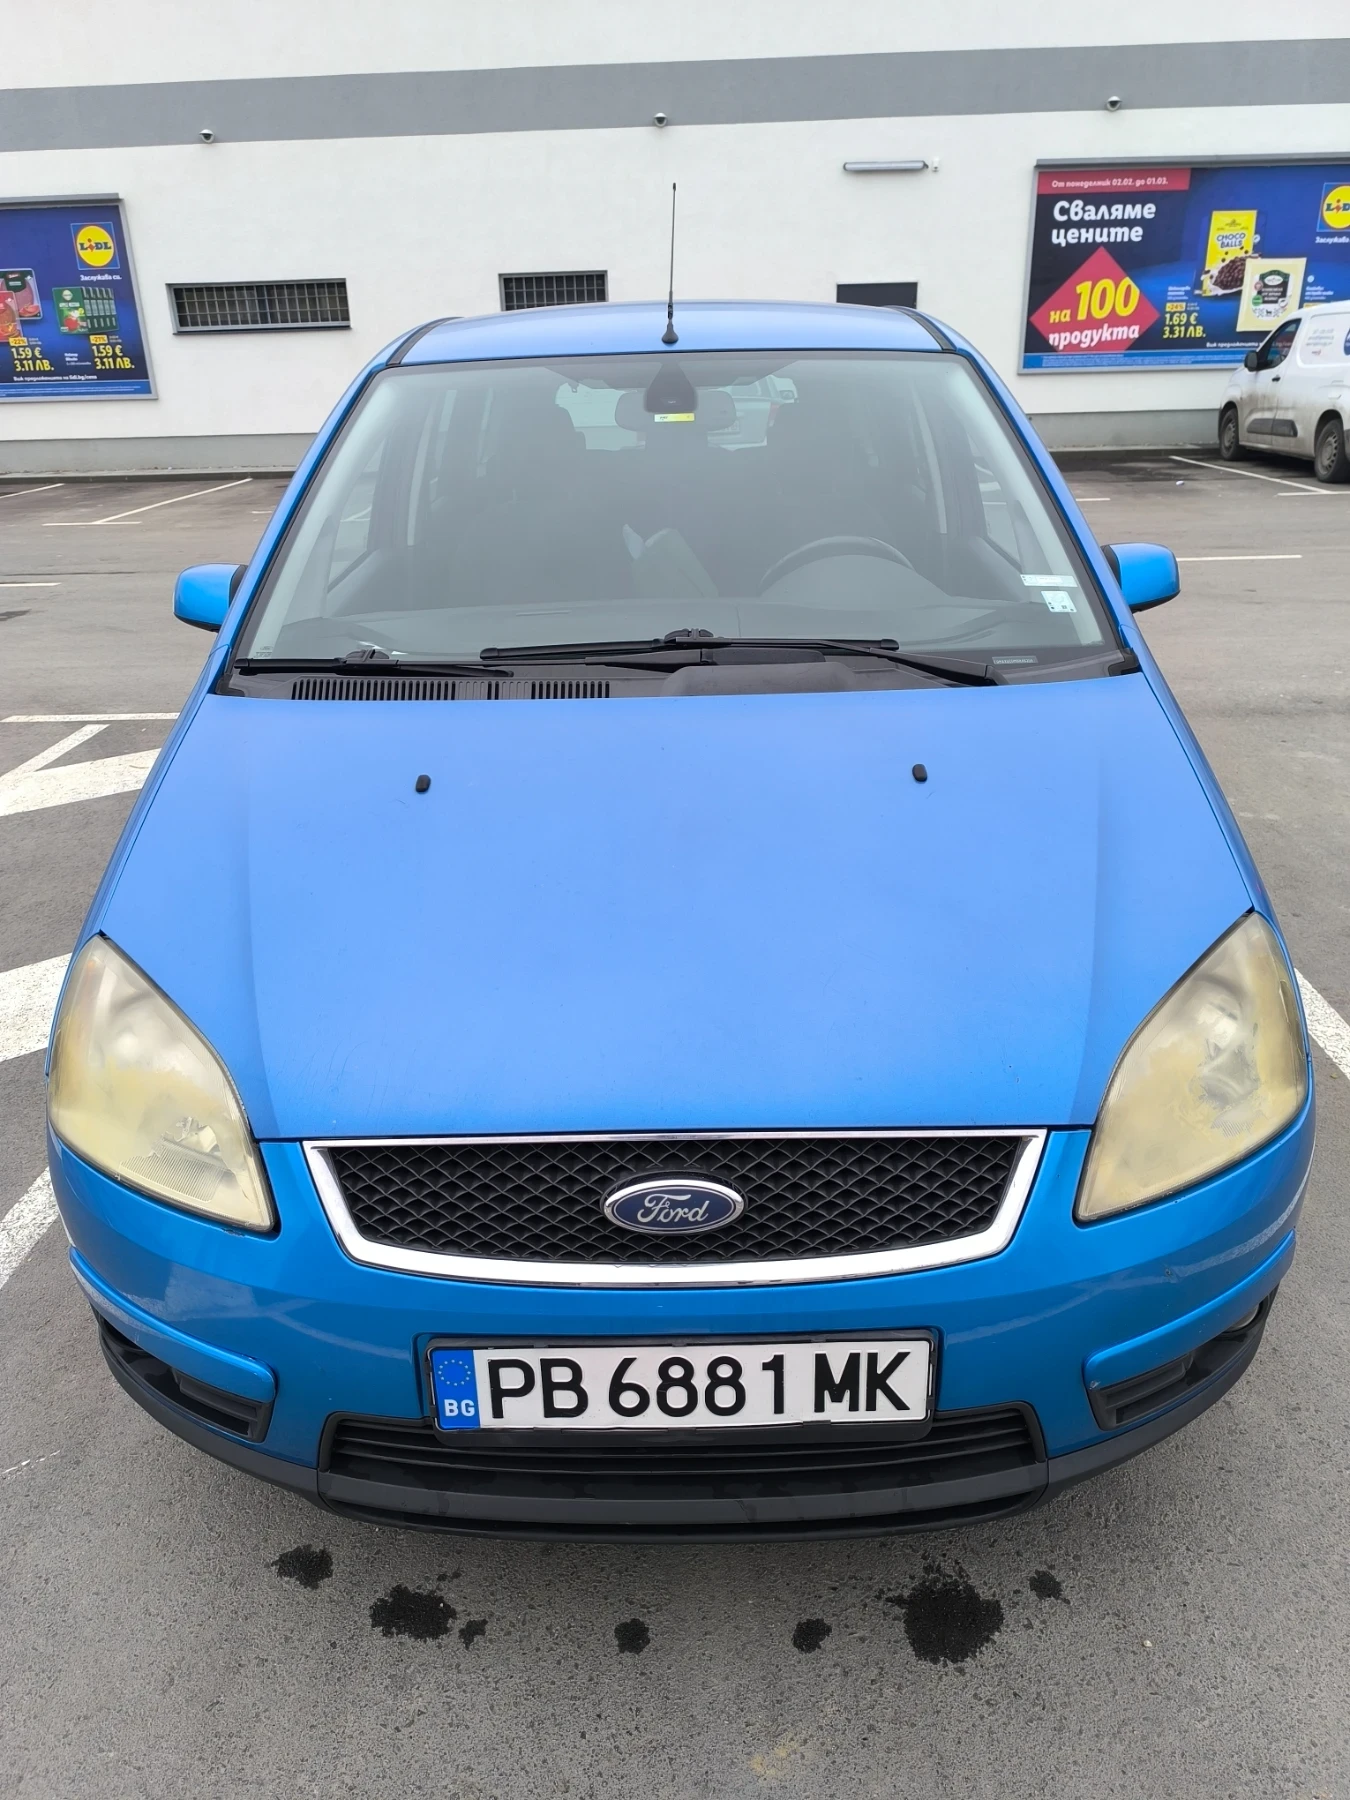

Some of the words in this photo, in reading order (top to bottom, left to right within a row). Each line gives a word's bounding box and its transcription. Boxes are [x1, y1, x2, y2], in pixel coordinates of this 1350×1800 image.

[1051, 180, 1065, 188] От
[1066, 178, 1111, 188] понеделник
[1135, 179, 1146, 187] до
[1053, 199, 1156, 222] Сваляме
[1325, 198, 1350, 214] LID
[1051, 225, 1143, 247] цените
[1216, 232, 1246, 242] CHOCO
[79, 238, 112, 252] LIDL
[1220, 239, 1243, 249] BALLS
[80, 273, 112, 281] Заслужава
[1049, 308, 1071, 324] на
[1076, 276, 1141, 320] 100
[1165, 312, 1187, 325] 1.69
[1189, 312, 1199, 325] €
[1049, 323, 1141, 350] продукта
[1162, 325, 1185, 338] 3.31
[1186, 325, 1206, 338] ЛВ.
[11, 347, 33, 359] 1.59
[34, 347, 43, 358] €
[92, 345, 113, 357] 1.59
[115, 345, 123, 356] €
[14, 360, 34, 371] 3.11
[35, 359, 55, 371] ЛВ.
[94, 357, 114, 369] 3.11
[116, 357, 135, 369] ЛВ.
[637, 1193, 709, 1223] Ford
[488, 1358, 589, 1419] PB
[608, 1354, 786, 1418] 6881
[813, 1351, 911, 1412] MK
[445, 1399, 475, 1418] BG
